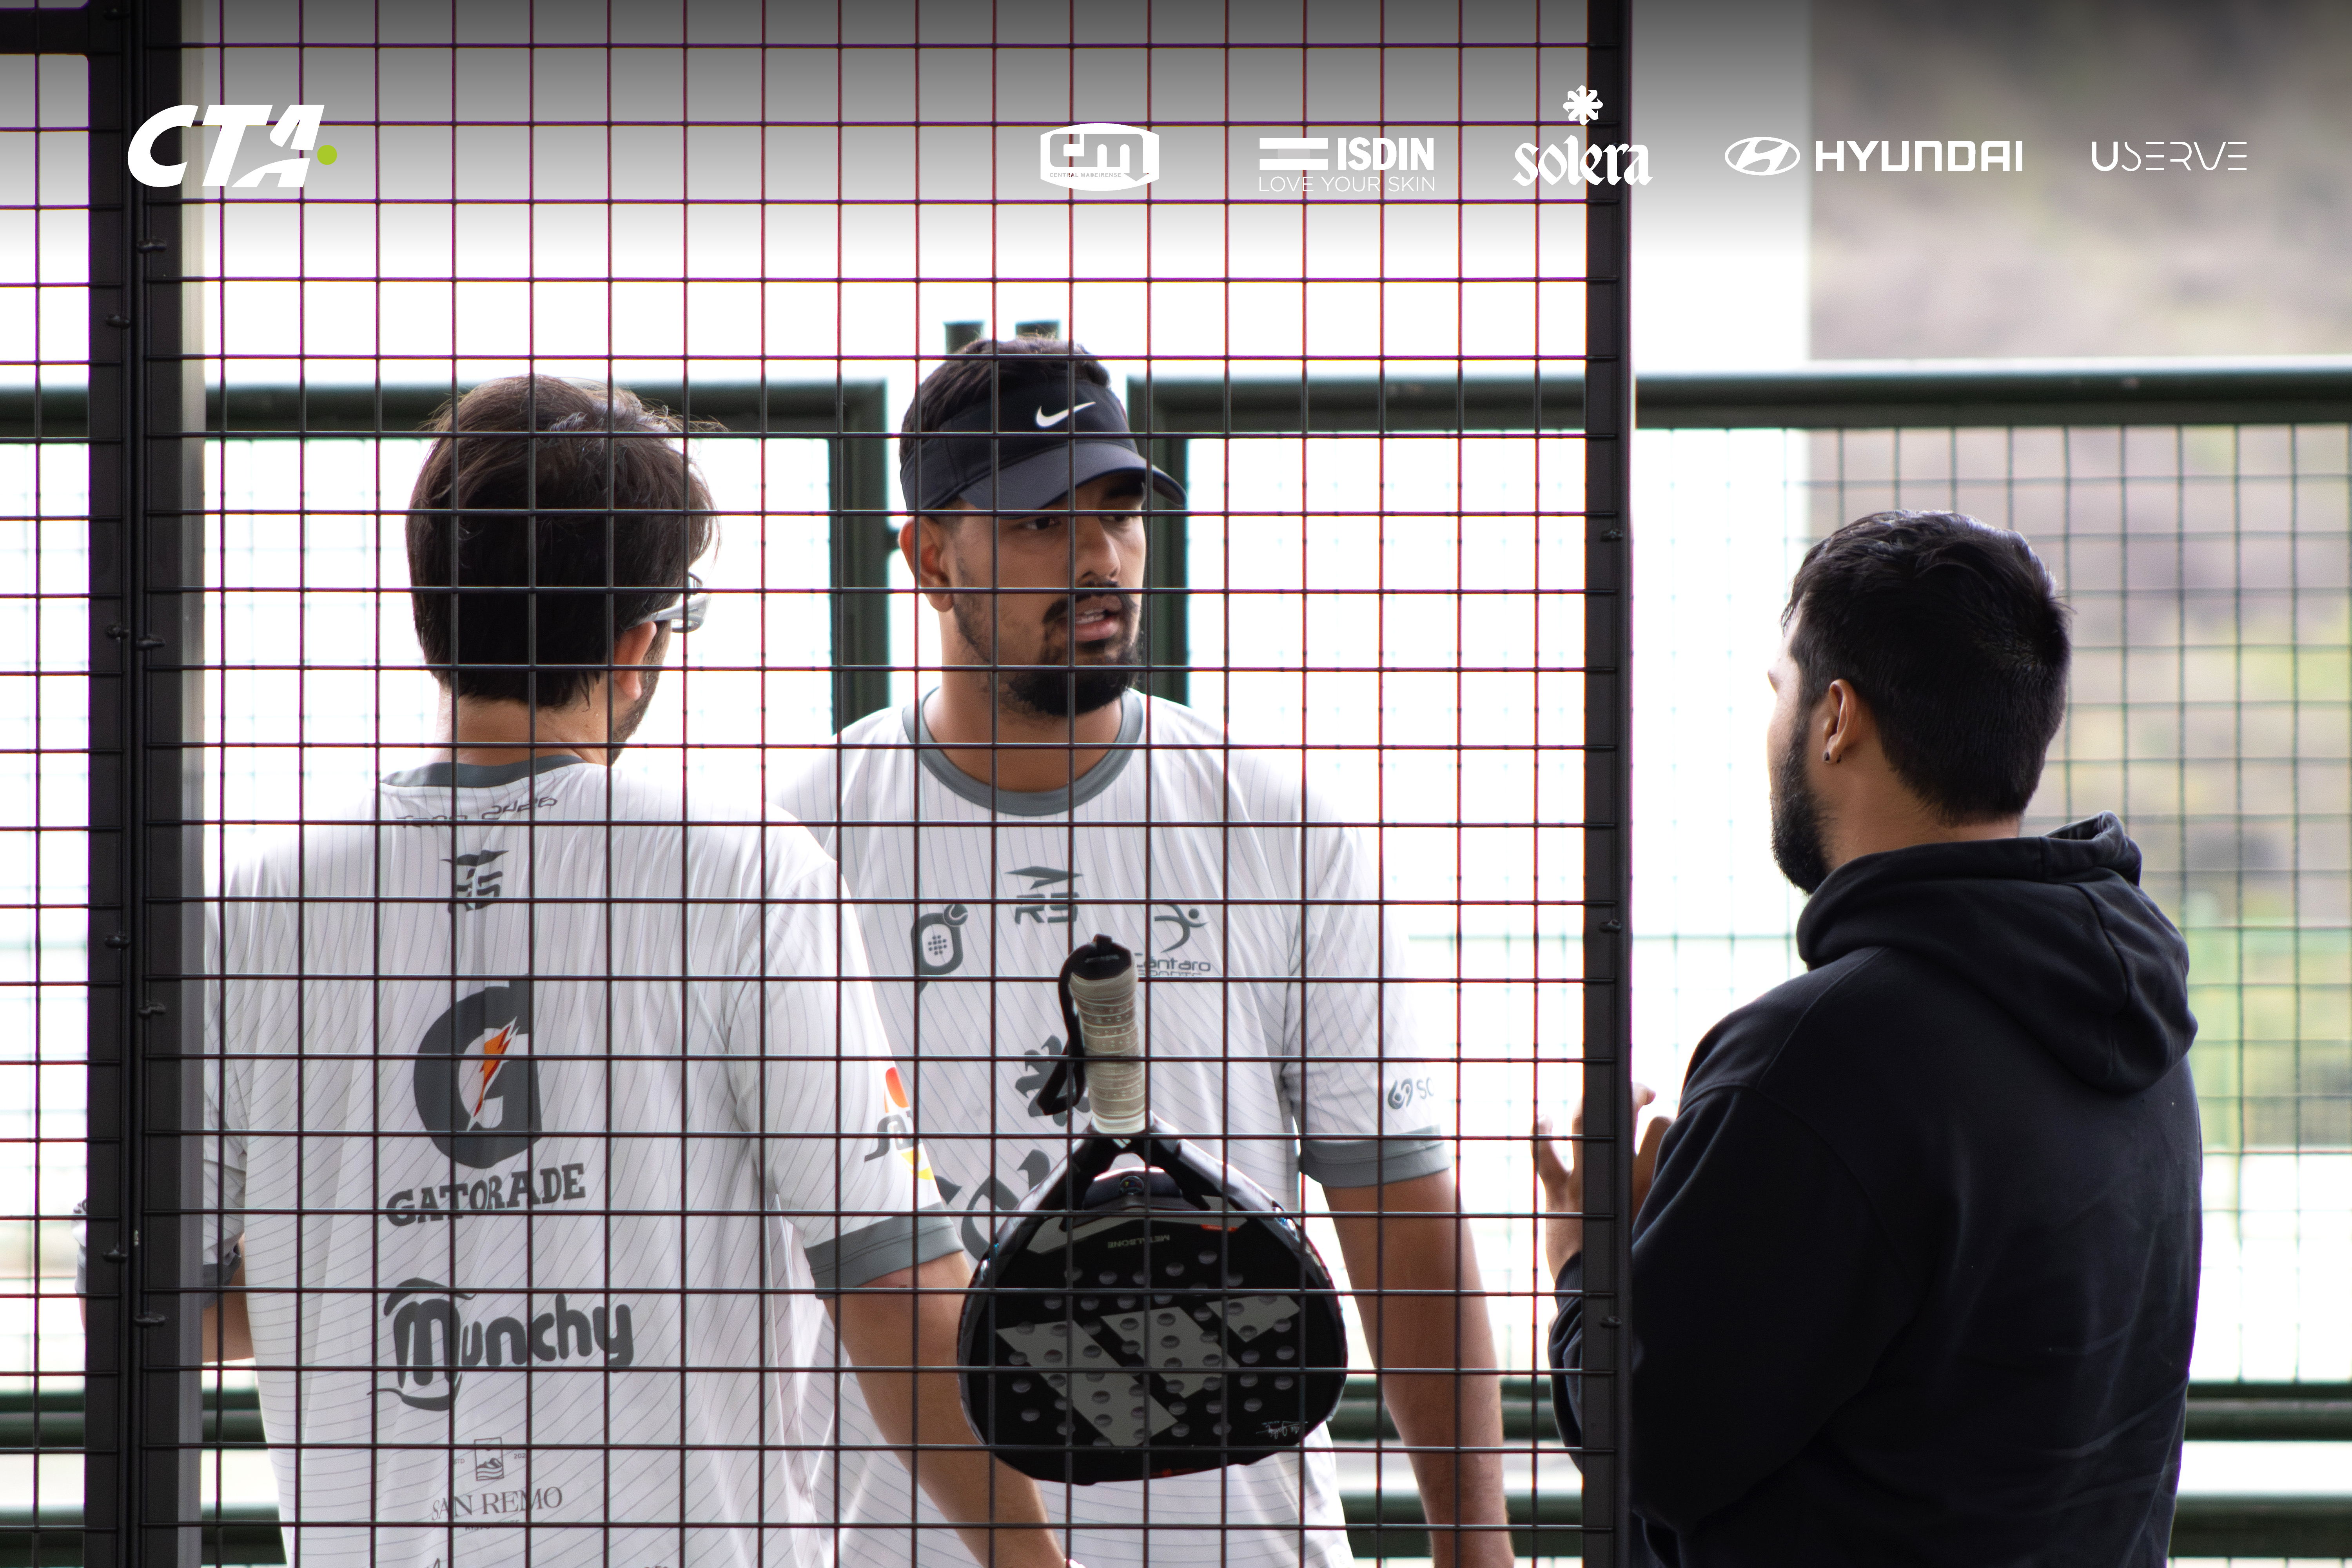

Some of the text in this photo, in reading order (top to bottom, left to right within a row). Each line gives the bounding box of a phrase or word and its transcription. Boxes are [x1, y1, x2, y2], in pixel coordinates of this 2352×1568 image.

[386, 1162, 586, 1227] GATORADE
[393, 1293, 634, 1388] Munchy
[432, 1486, 563, 1521] SAN REMO
